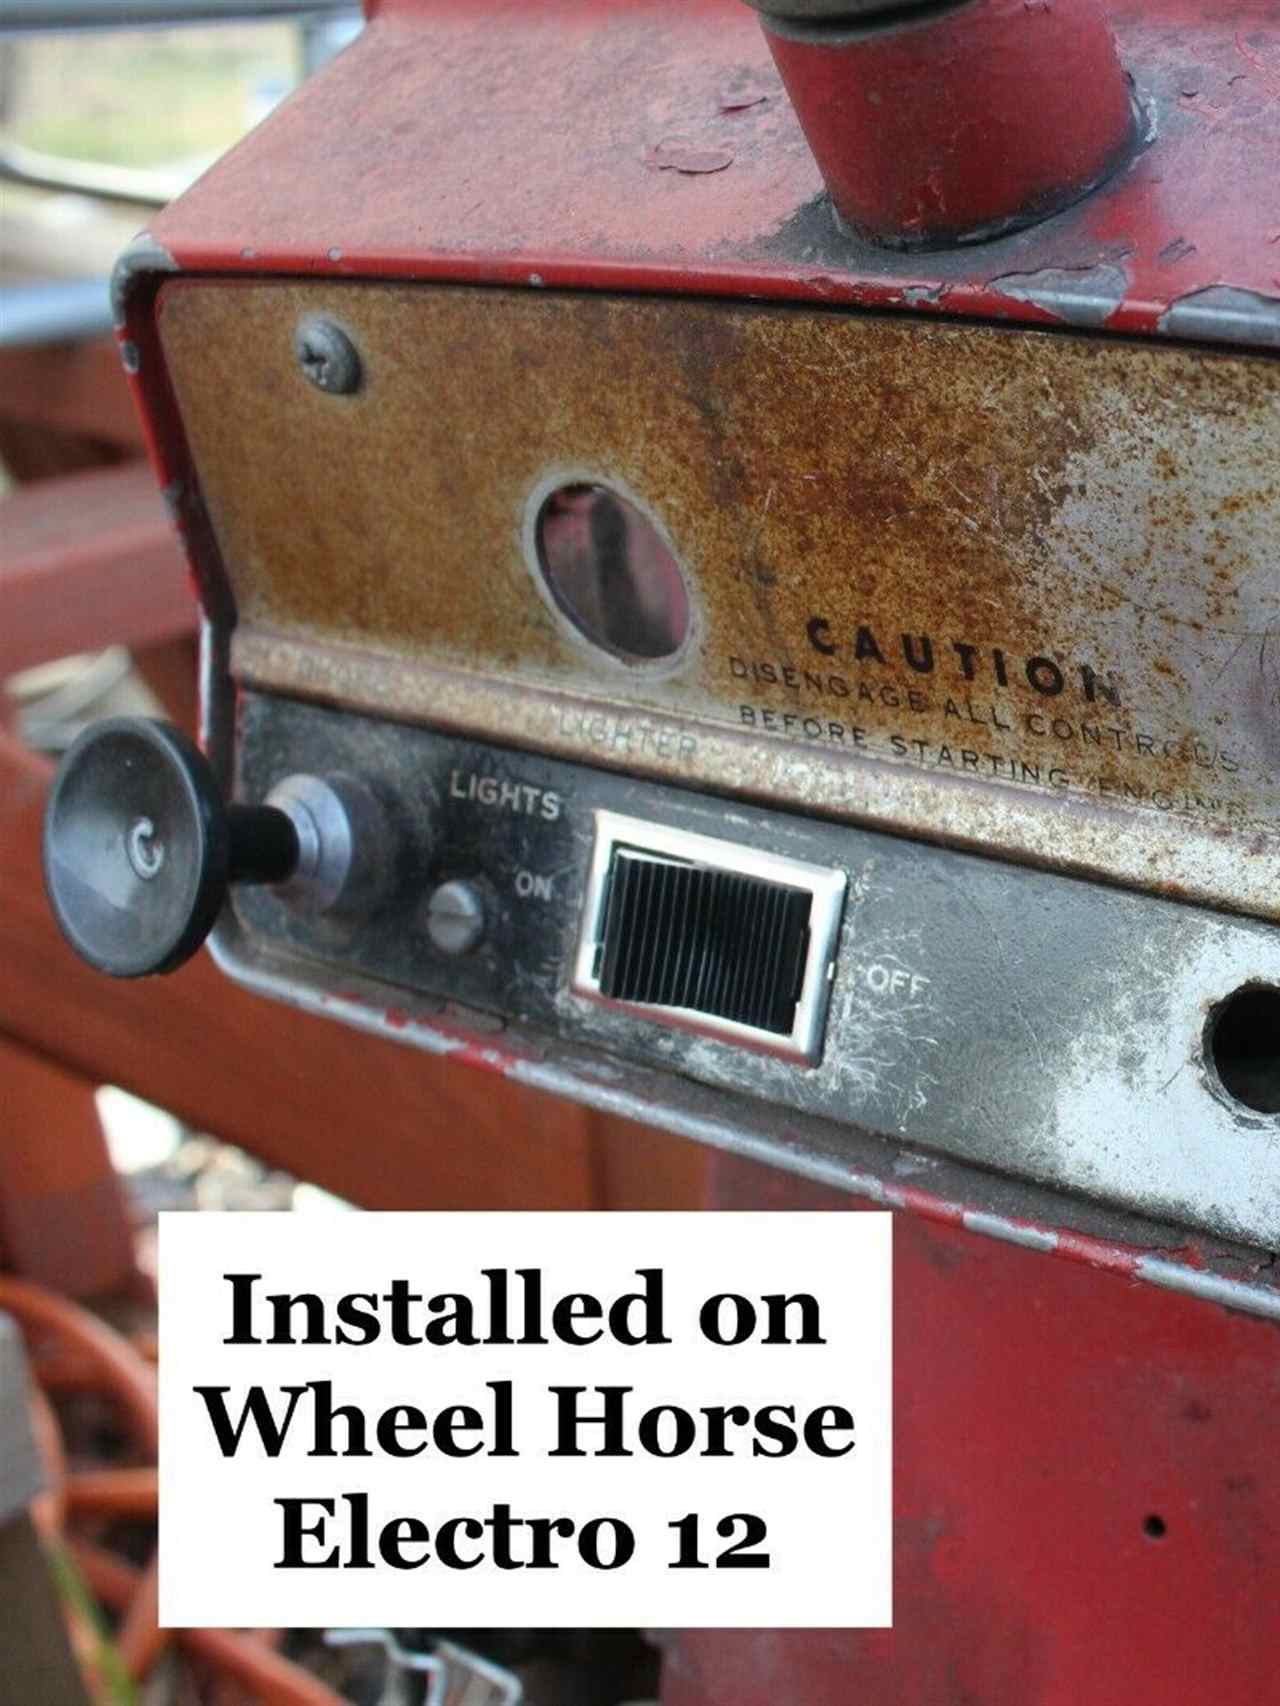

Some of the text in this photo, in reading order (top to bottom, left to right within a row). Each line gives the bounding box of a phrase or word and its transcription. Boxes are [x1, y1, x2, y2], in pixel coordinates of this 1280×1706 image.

[806, 615, 1122, 708] CAUTION
[729, 655, 930, 713] DISENGAGE
[944, 697, 1010, 731] ALL
[554, 712, 698, 763] LIGHTER
[739, 704, 1248, 819] BEFORE STARTING ENGIN
[449, 768, 560, 820] LIGHTS
[514, 869, 555, 903] ON
[865, 964, 932, 999] OFF
